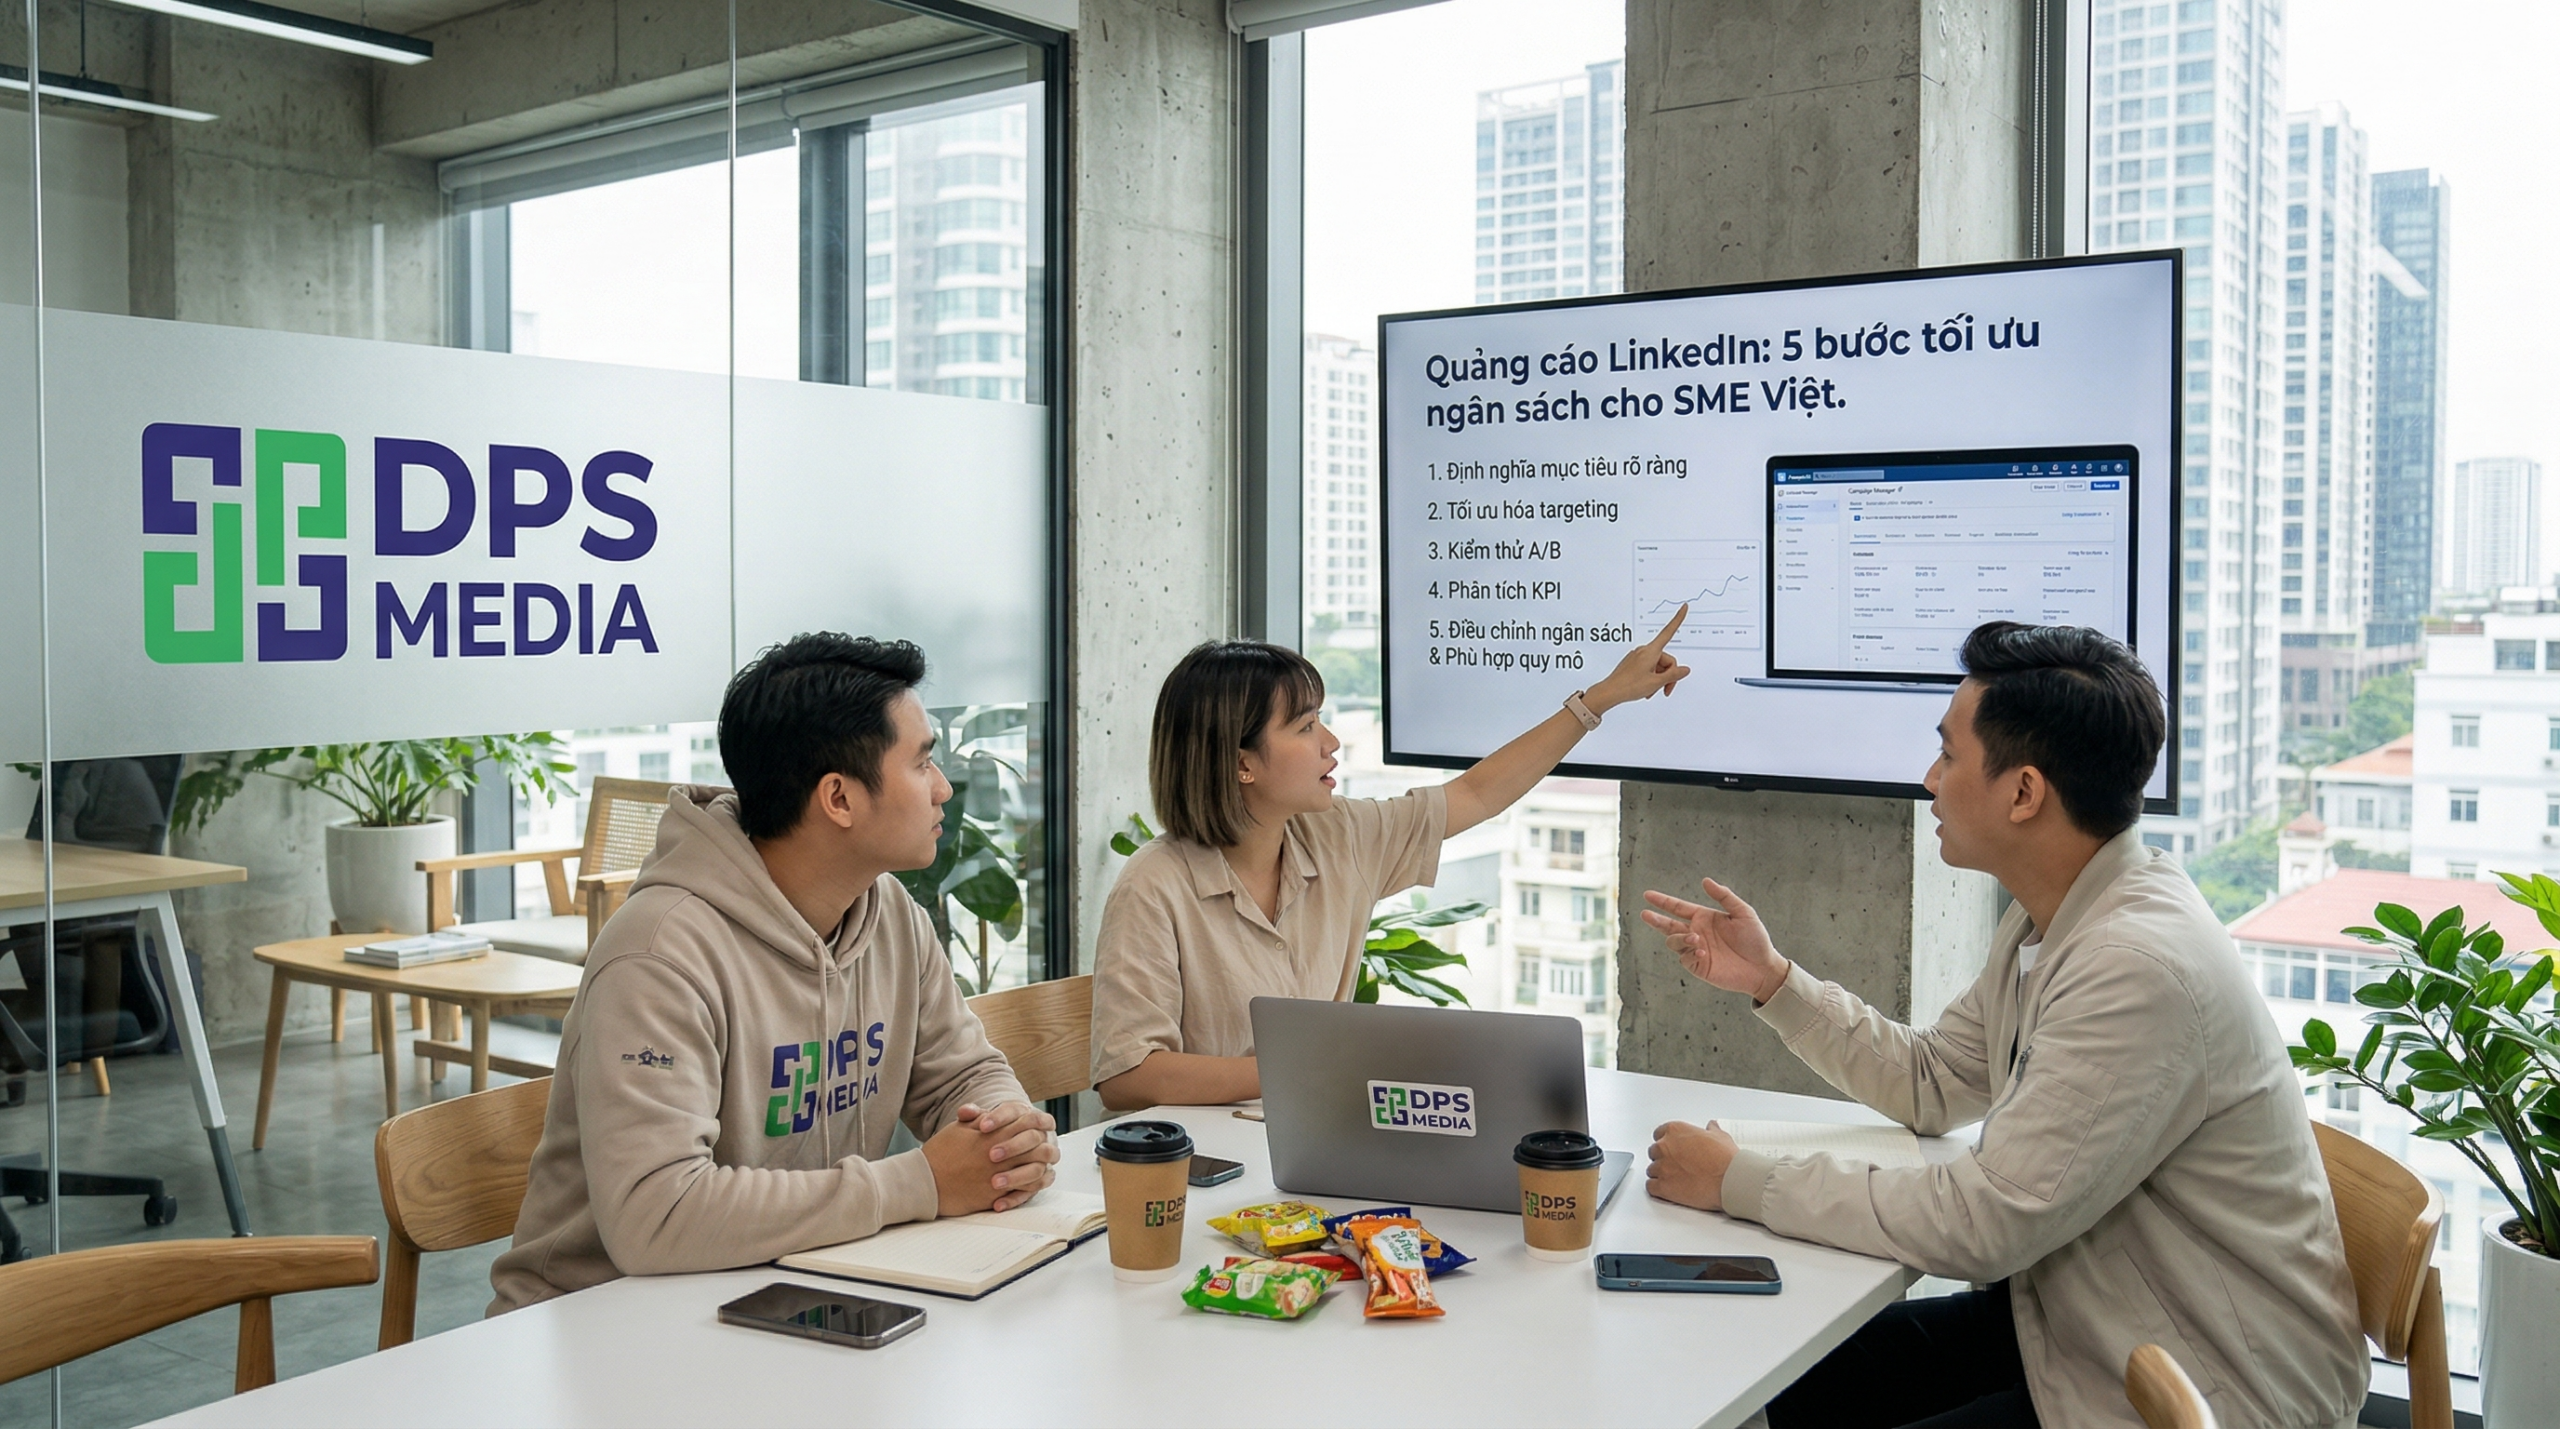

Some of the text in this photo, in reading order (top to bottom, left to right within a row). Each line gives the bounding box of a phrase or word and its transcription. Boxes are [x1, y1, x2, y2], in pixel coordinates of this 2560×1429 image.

[1425, 312, 2040, 389] Quảng cáo LinkedIn: 5 bước tối ưu
[1427, 375, 1846, 434] ngân sách cho SME Việt.
[1428, 454, 1687, 484] 1. Định nghĩa mục tiêu rõ ràng
[374, 436, 659, 562] DPS
[1427, 498, 1618, 523] 2. Tối ưu hóa targeting
[1428, 538, 1561, 561] 3. Kiểm thử A/B
[1428, 579, 1561, 600] 4. Phân tích KPI
[374, 580, 660, 660] MEDIA
[1429, 617, 1632, 646] 5. Điều chỉnh ngân sách
[1429, 646, 1584, 674] & Phù hợp quy mô
[1409, 1088, 1471, 1114] DPS
[1411, 1113, 1472, 1131] MEDIA
[1541, 1195, 1577, 1210] DPS
[1542, 1210, 1576, 1221] MEDIA
